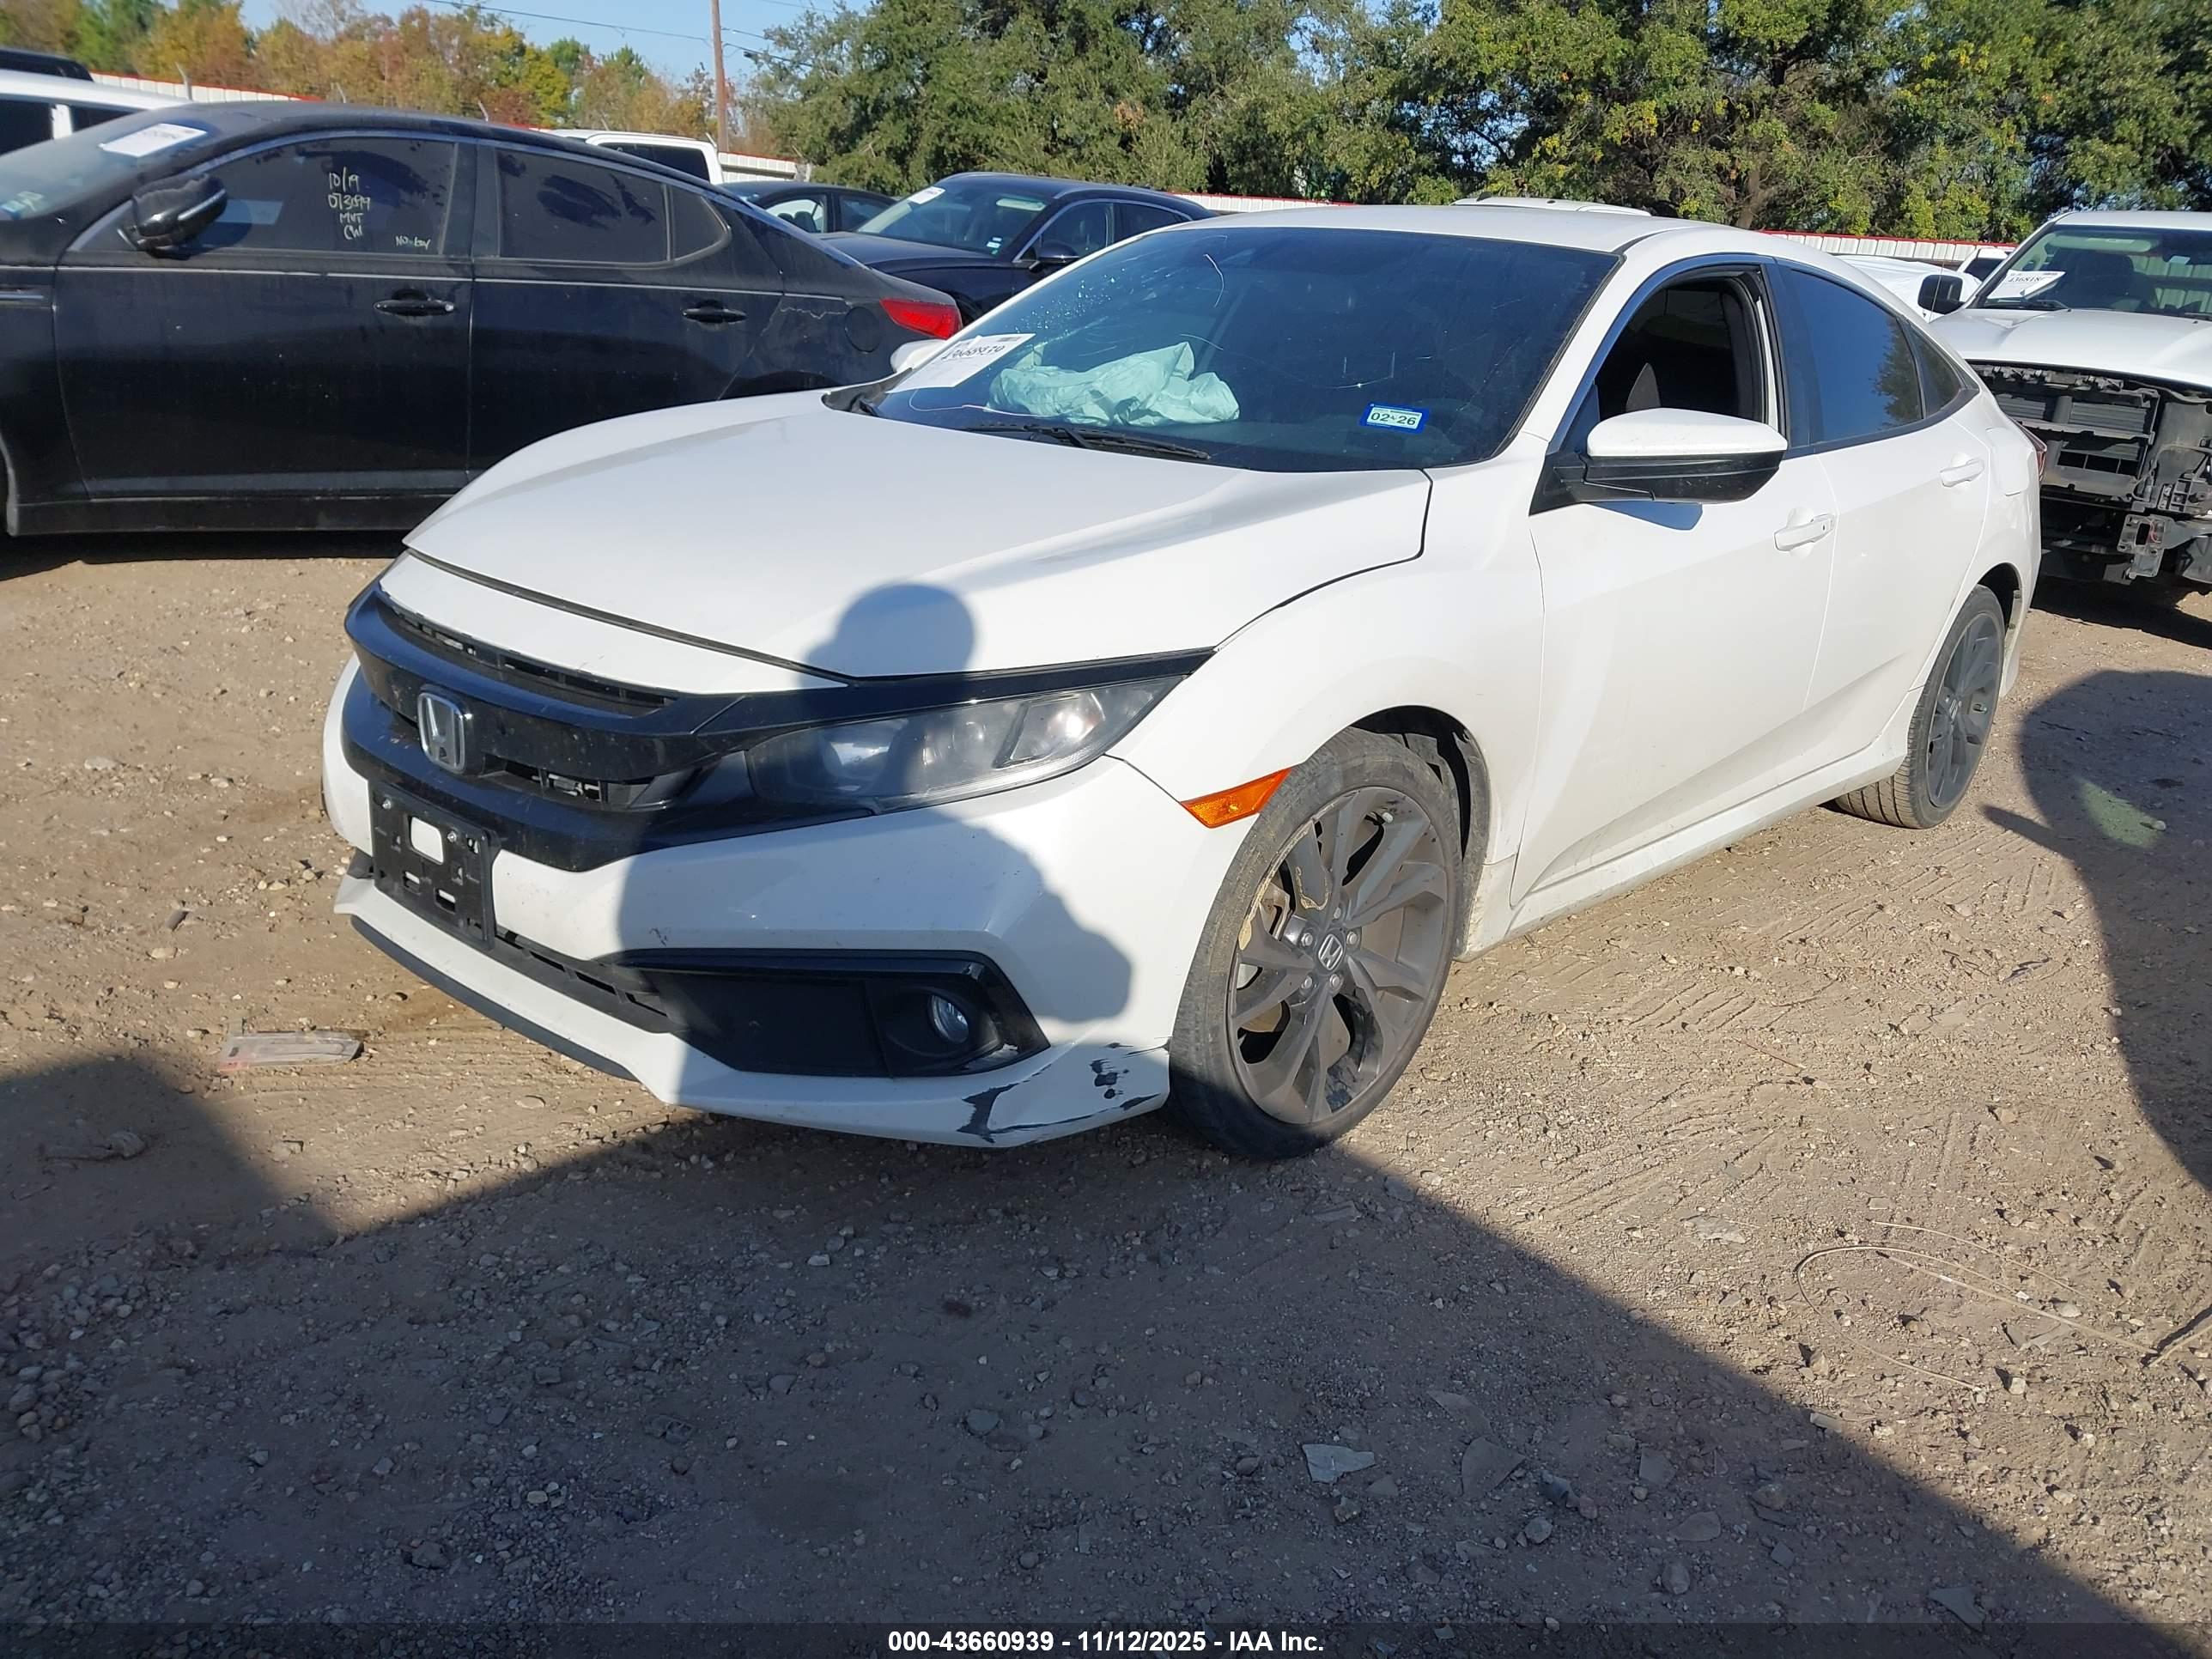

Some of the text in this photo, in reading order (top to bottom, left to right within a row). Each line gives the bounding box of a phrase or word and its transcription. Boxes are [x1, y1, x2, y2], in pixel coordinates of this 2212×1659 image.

[329, 166, 361, 192] 10/19
[1370, 412, 1390, 422] 02
[1396, 415, 1418, 426] 26
